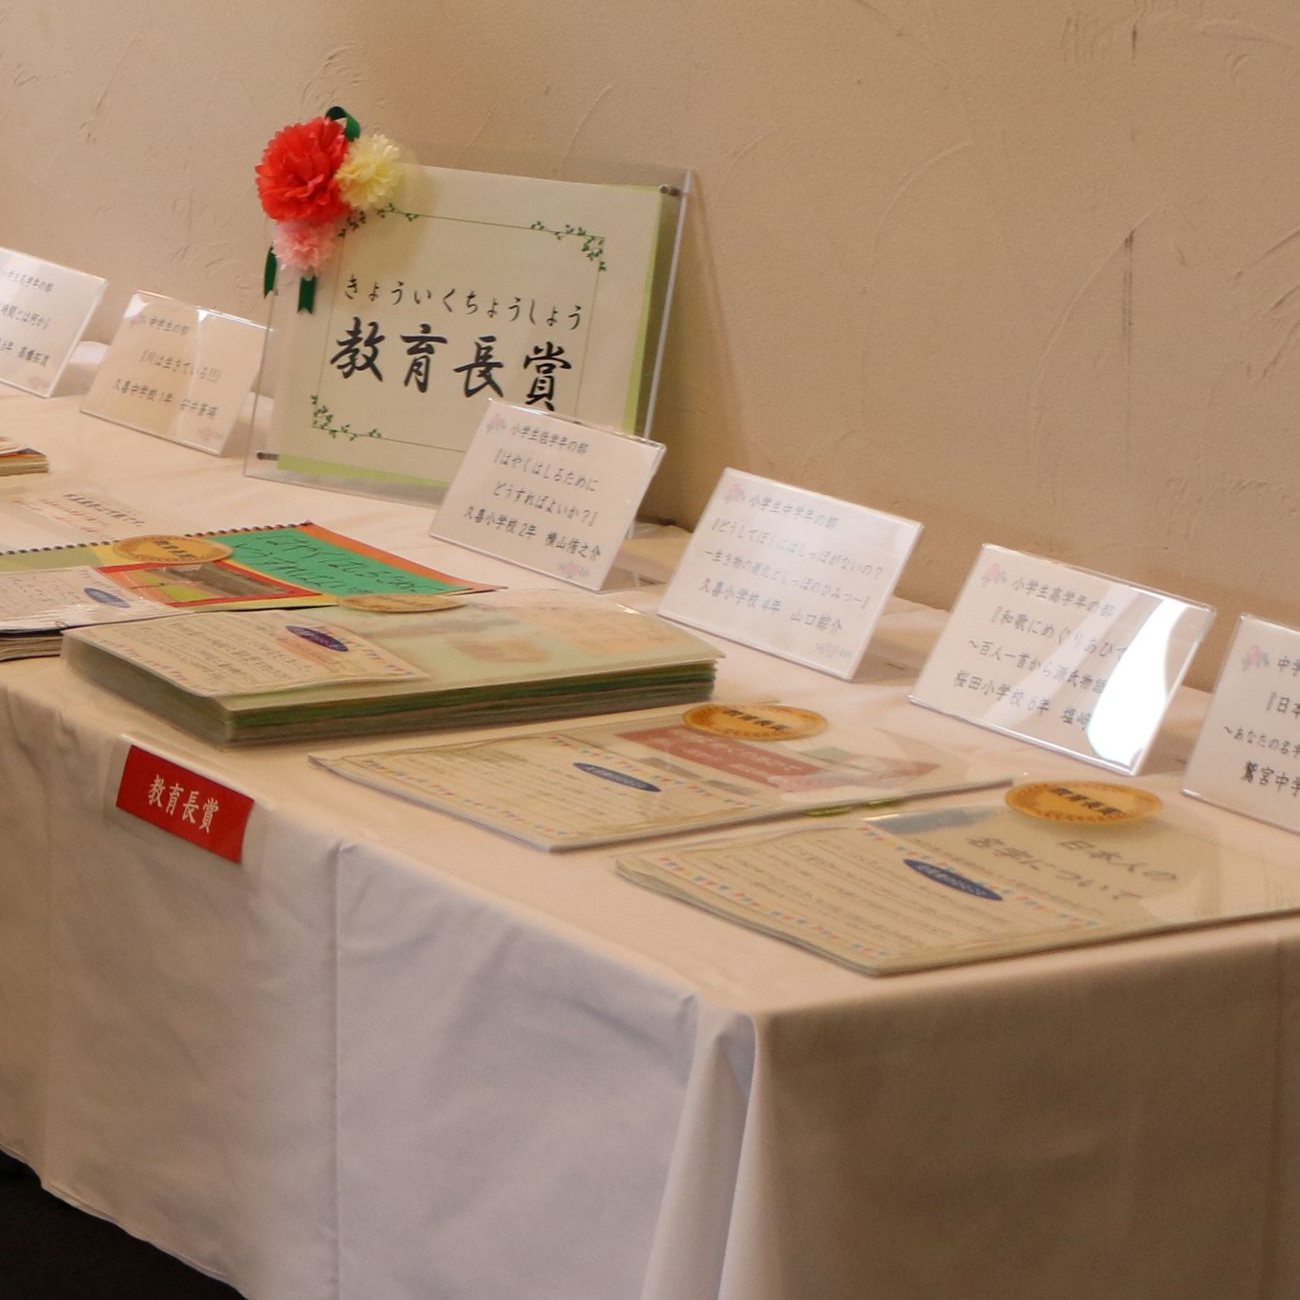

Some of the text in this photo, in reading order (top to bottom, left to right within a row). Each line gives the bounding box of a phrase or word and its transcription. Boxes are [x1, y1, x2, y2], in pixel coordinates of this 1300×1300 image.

[345, 274, 582, 331] きょういくちょうしょう
[330, 317, 572, 412] 教育長賞
[148, 774, 220, 834] 教育長賞
